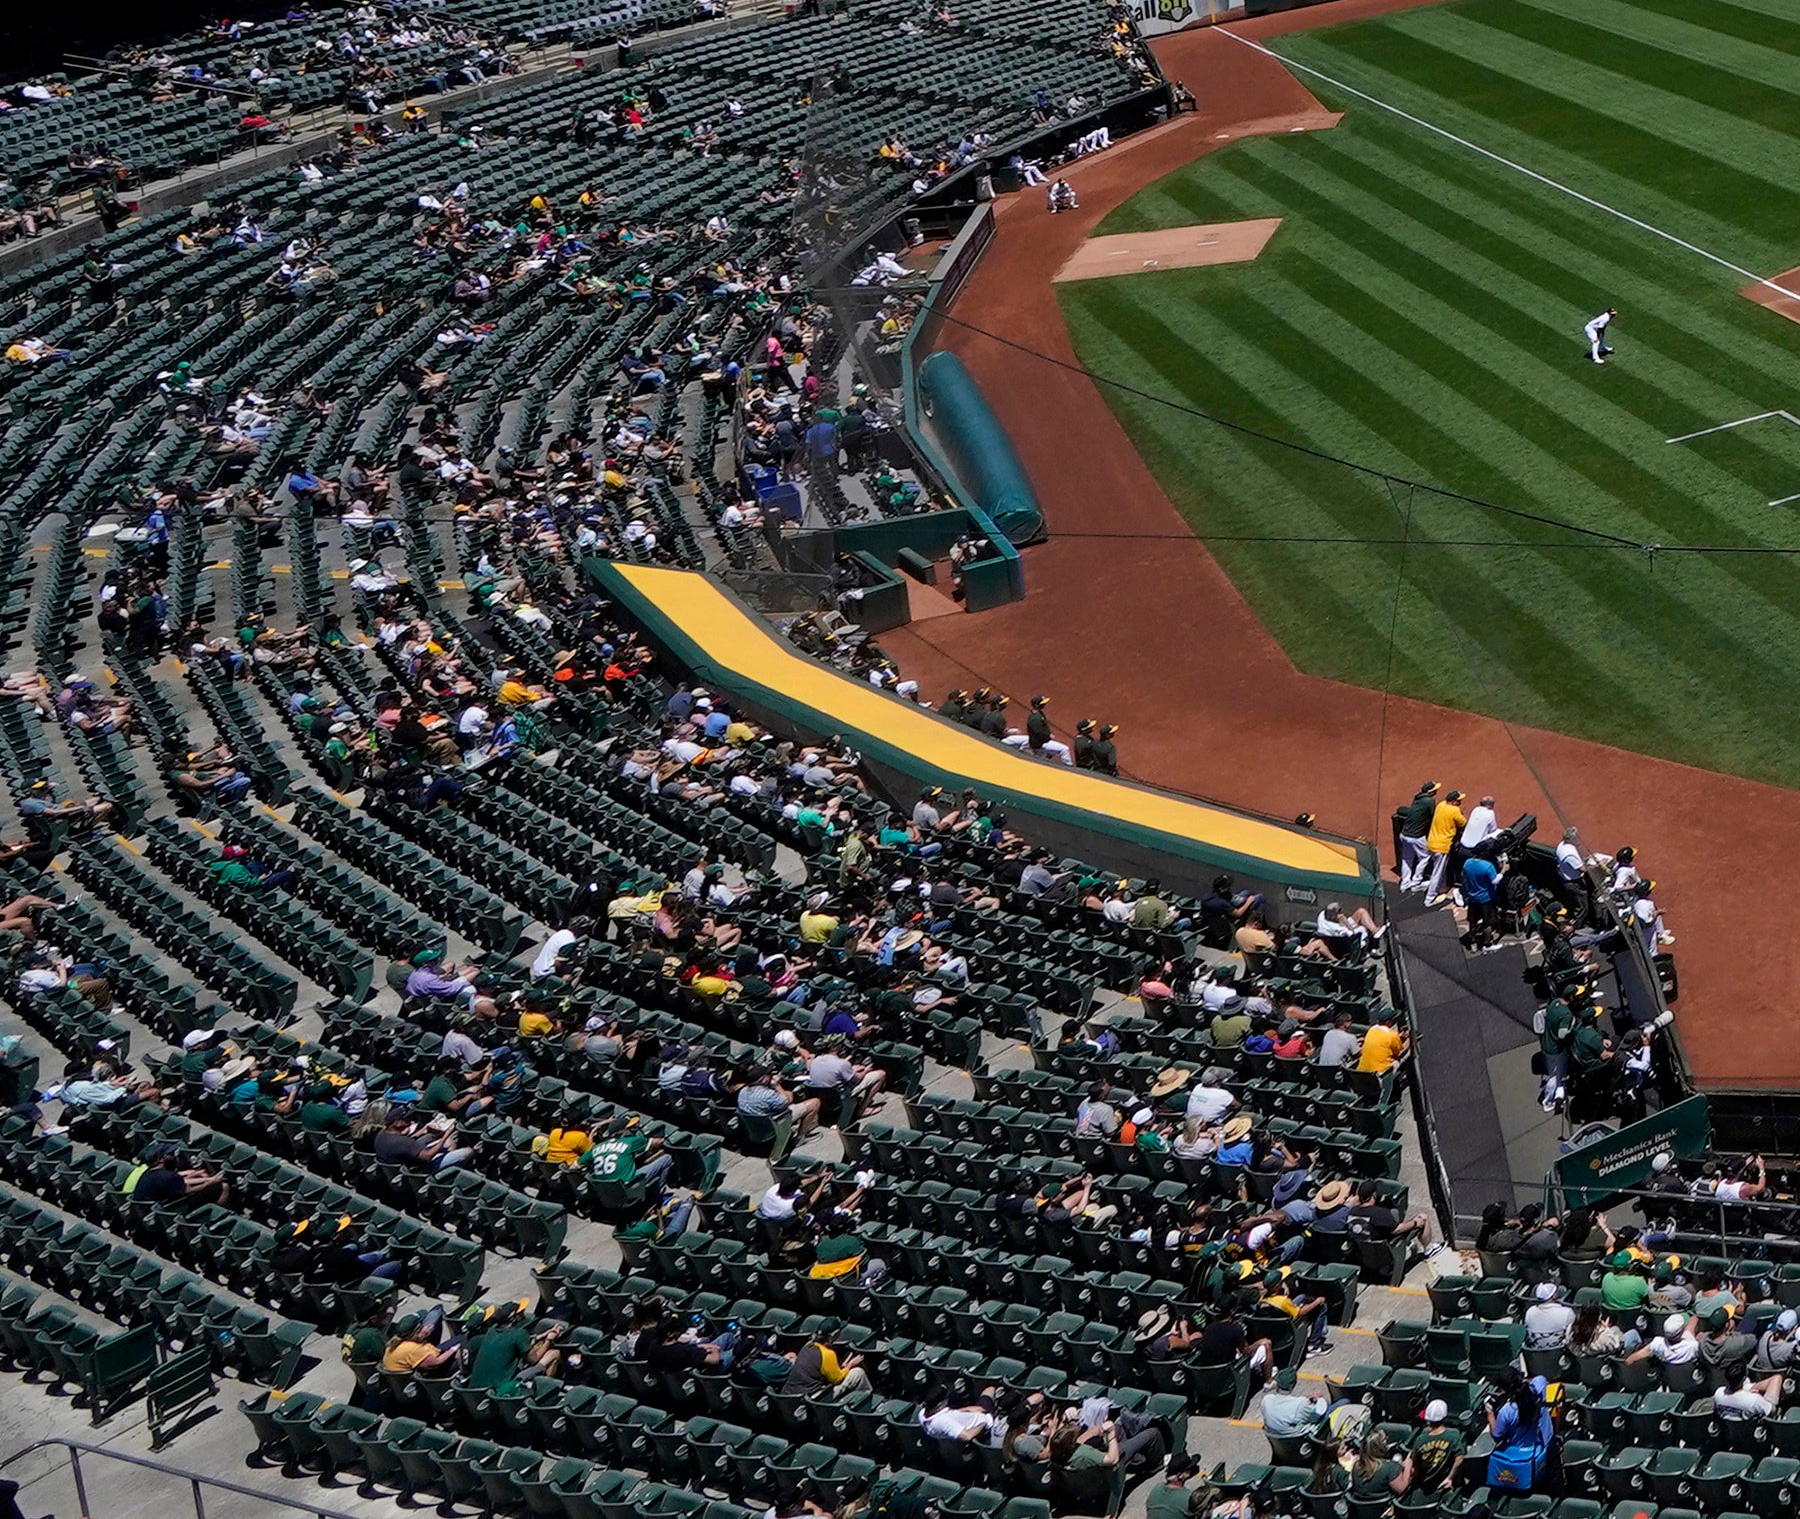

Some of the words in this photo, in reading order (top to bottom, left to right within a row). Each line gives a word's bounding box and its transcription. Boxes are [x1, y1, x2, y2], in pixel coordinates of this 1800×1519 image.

[1598, 1153, 1645, 1178] DIAMOND
[1646, 1141, 1671, 1157] LEVEL
[1602, 1140, 1653, 1164] Mechanics
[593, 1153, 619, 1176] 26
